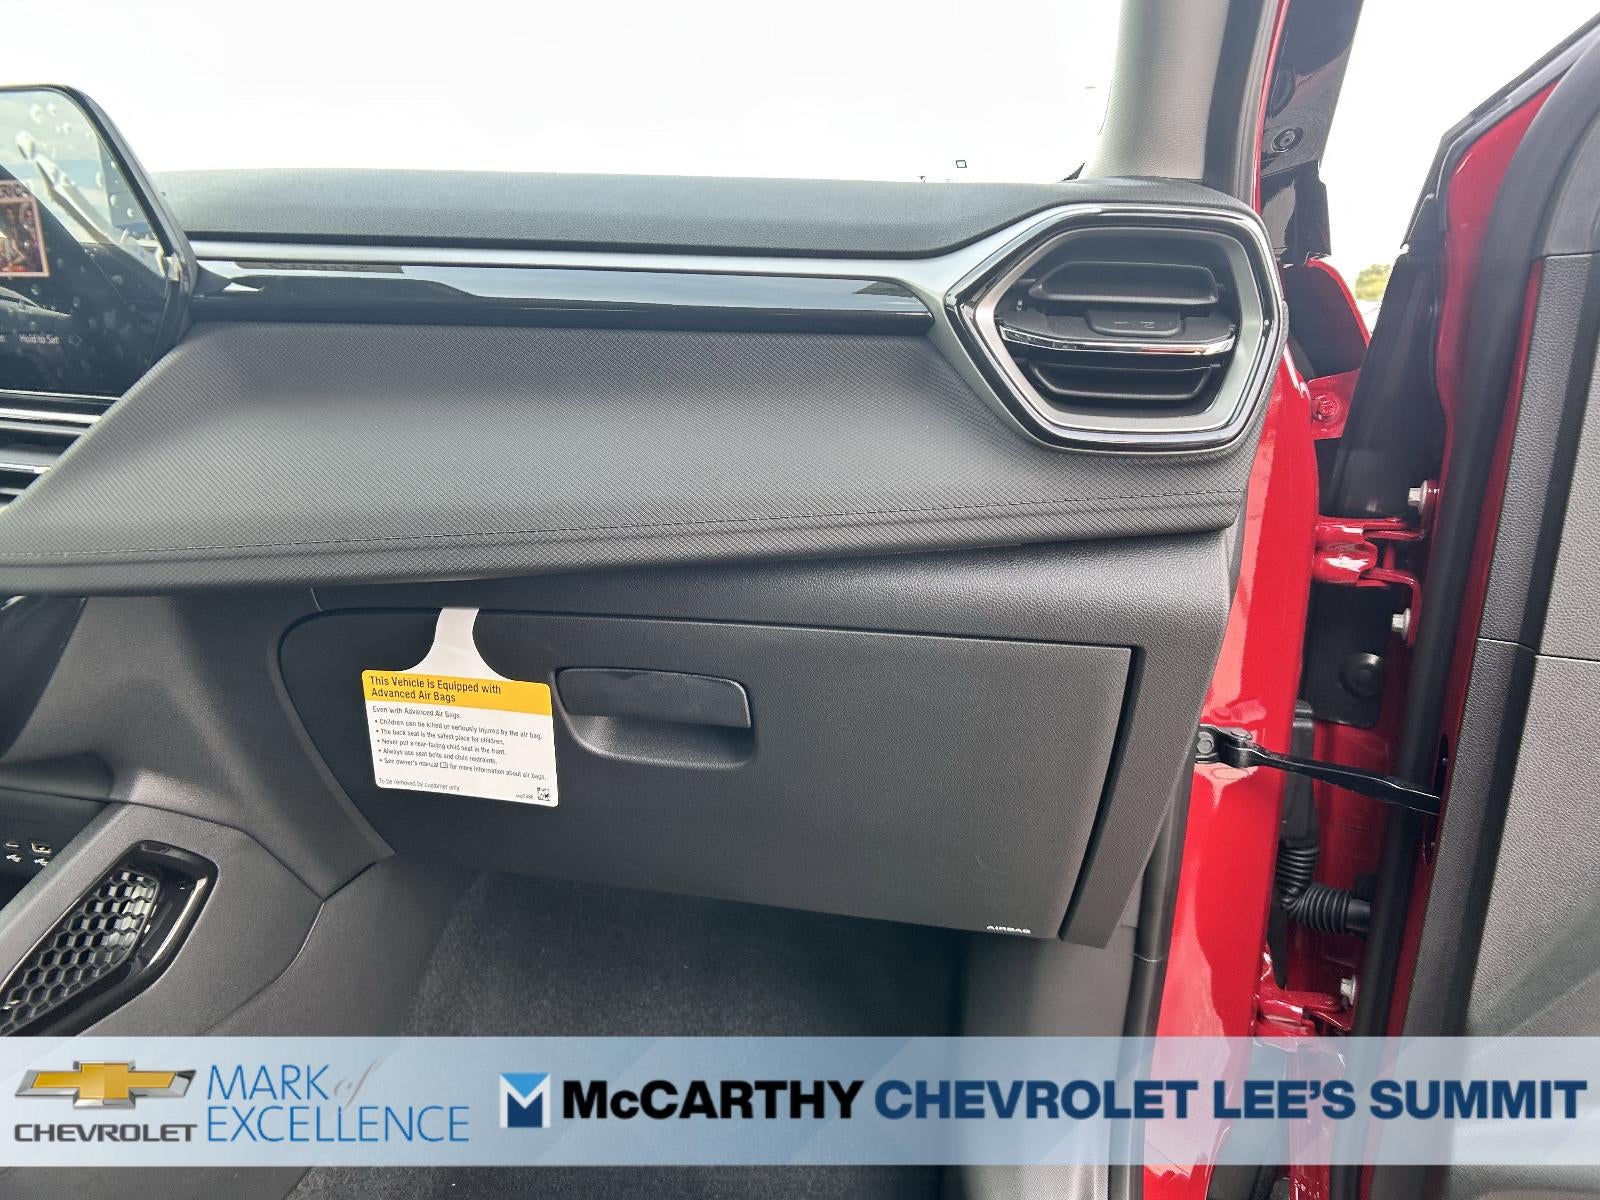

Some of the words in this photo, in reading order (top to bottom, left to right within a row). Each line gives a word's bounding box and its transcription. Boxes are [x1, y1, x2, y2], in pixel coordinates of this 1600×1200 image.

[370, 676, 389, 686] This
[392, 677, 425, 688] Vehicle
[427, 679, 435, 689] is
[438, 680, 479, 693] Equipped
[482, 684, 501, 694] with
[372, 688, 416, 699] Advanced
[419, 691, 431, 700] Air
[434, 692, 456, 703] Bags
[389, 706, 403, 714] with
[405, 708, 433, 717] Advanced
[445, 711, 460, 719] Bags
[451, 725, 477, 733] seriously
[479, 727, 500, 735] injured
